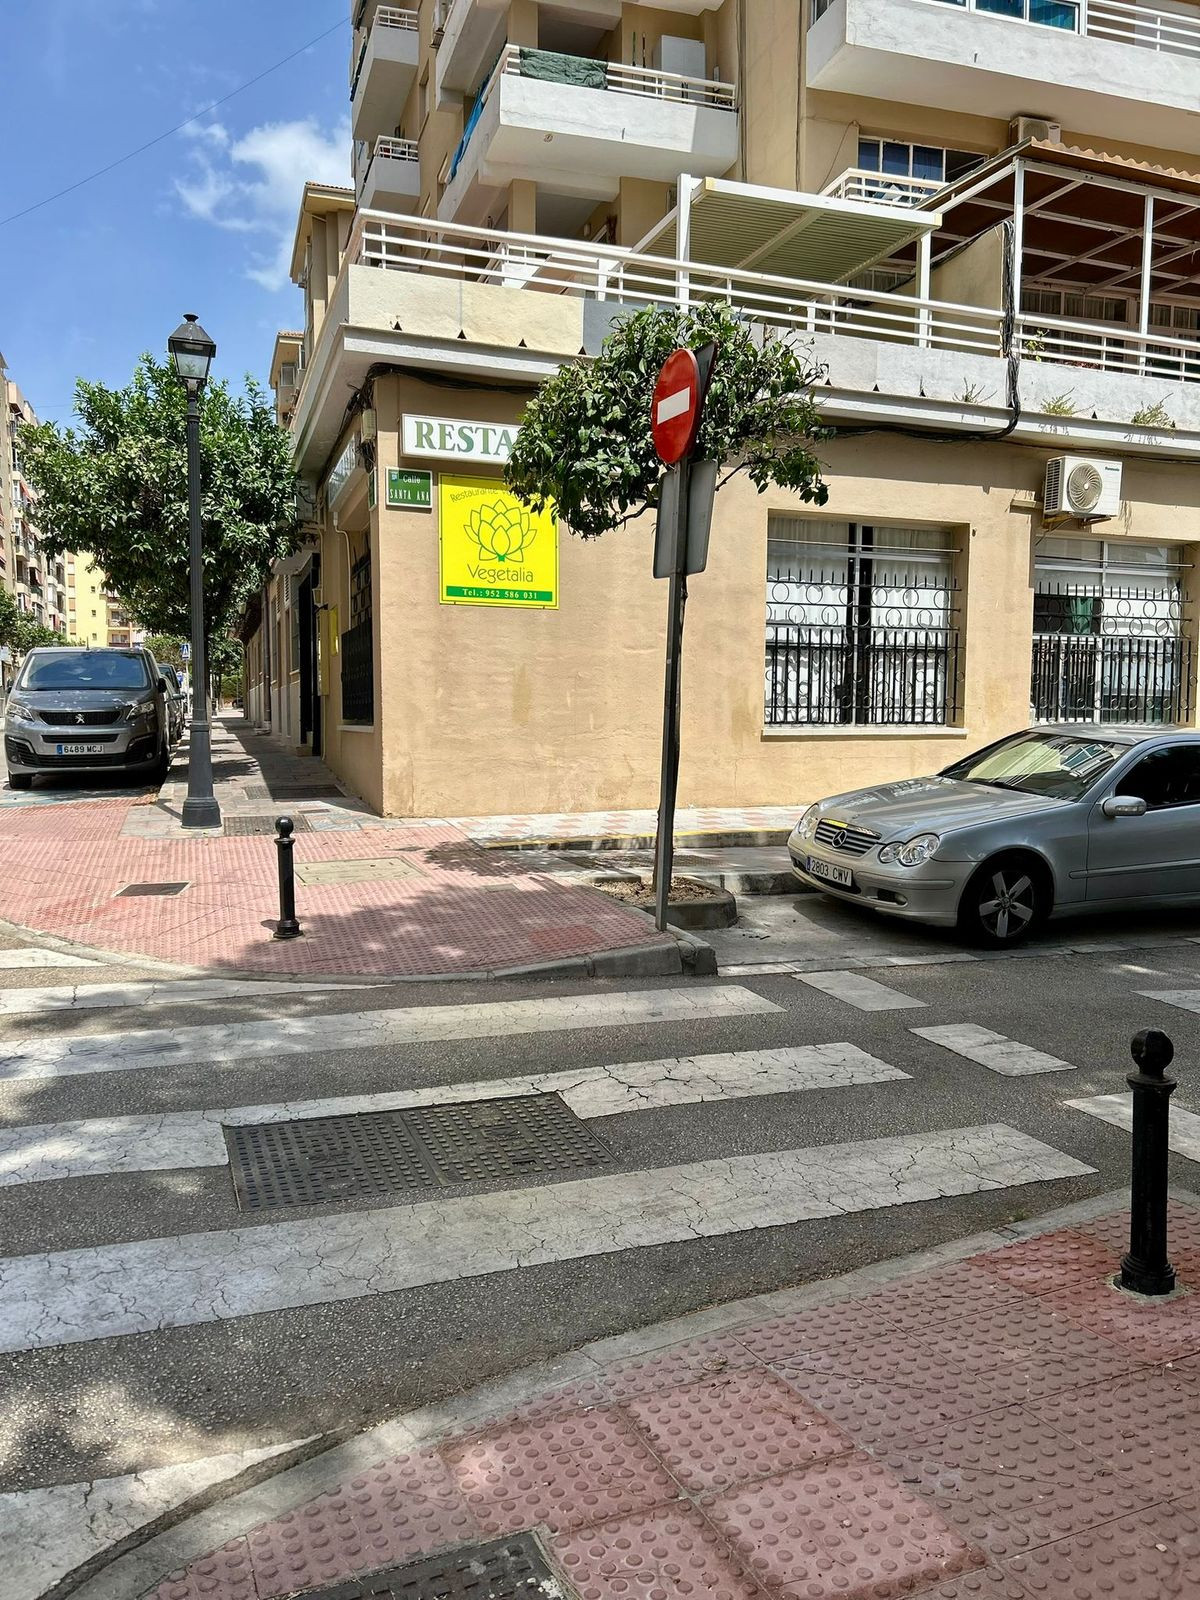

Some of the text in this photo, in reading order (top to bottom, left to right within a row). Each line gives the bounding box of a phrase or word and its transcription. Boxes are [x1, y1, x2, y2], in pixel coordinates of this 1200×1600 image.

[414, 420, 514, 456] RESTA
[402, 475, 421, 483] Calle
[389, 488, 430, 502] SANTA ANA
[467, 563, 534, 584] Vegetalia
[485, 589, 500, 598] 952
[504, 591, 519, 599] 586
[523, 592, 537, 600] 031
[64, 745, 103, 753] 6489 MCJ
[811, 859, 828, 877] 2803
